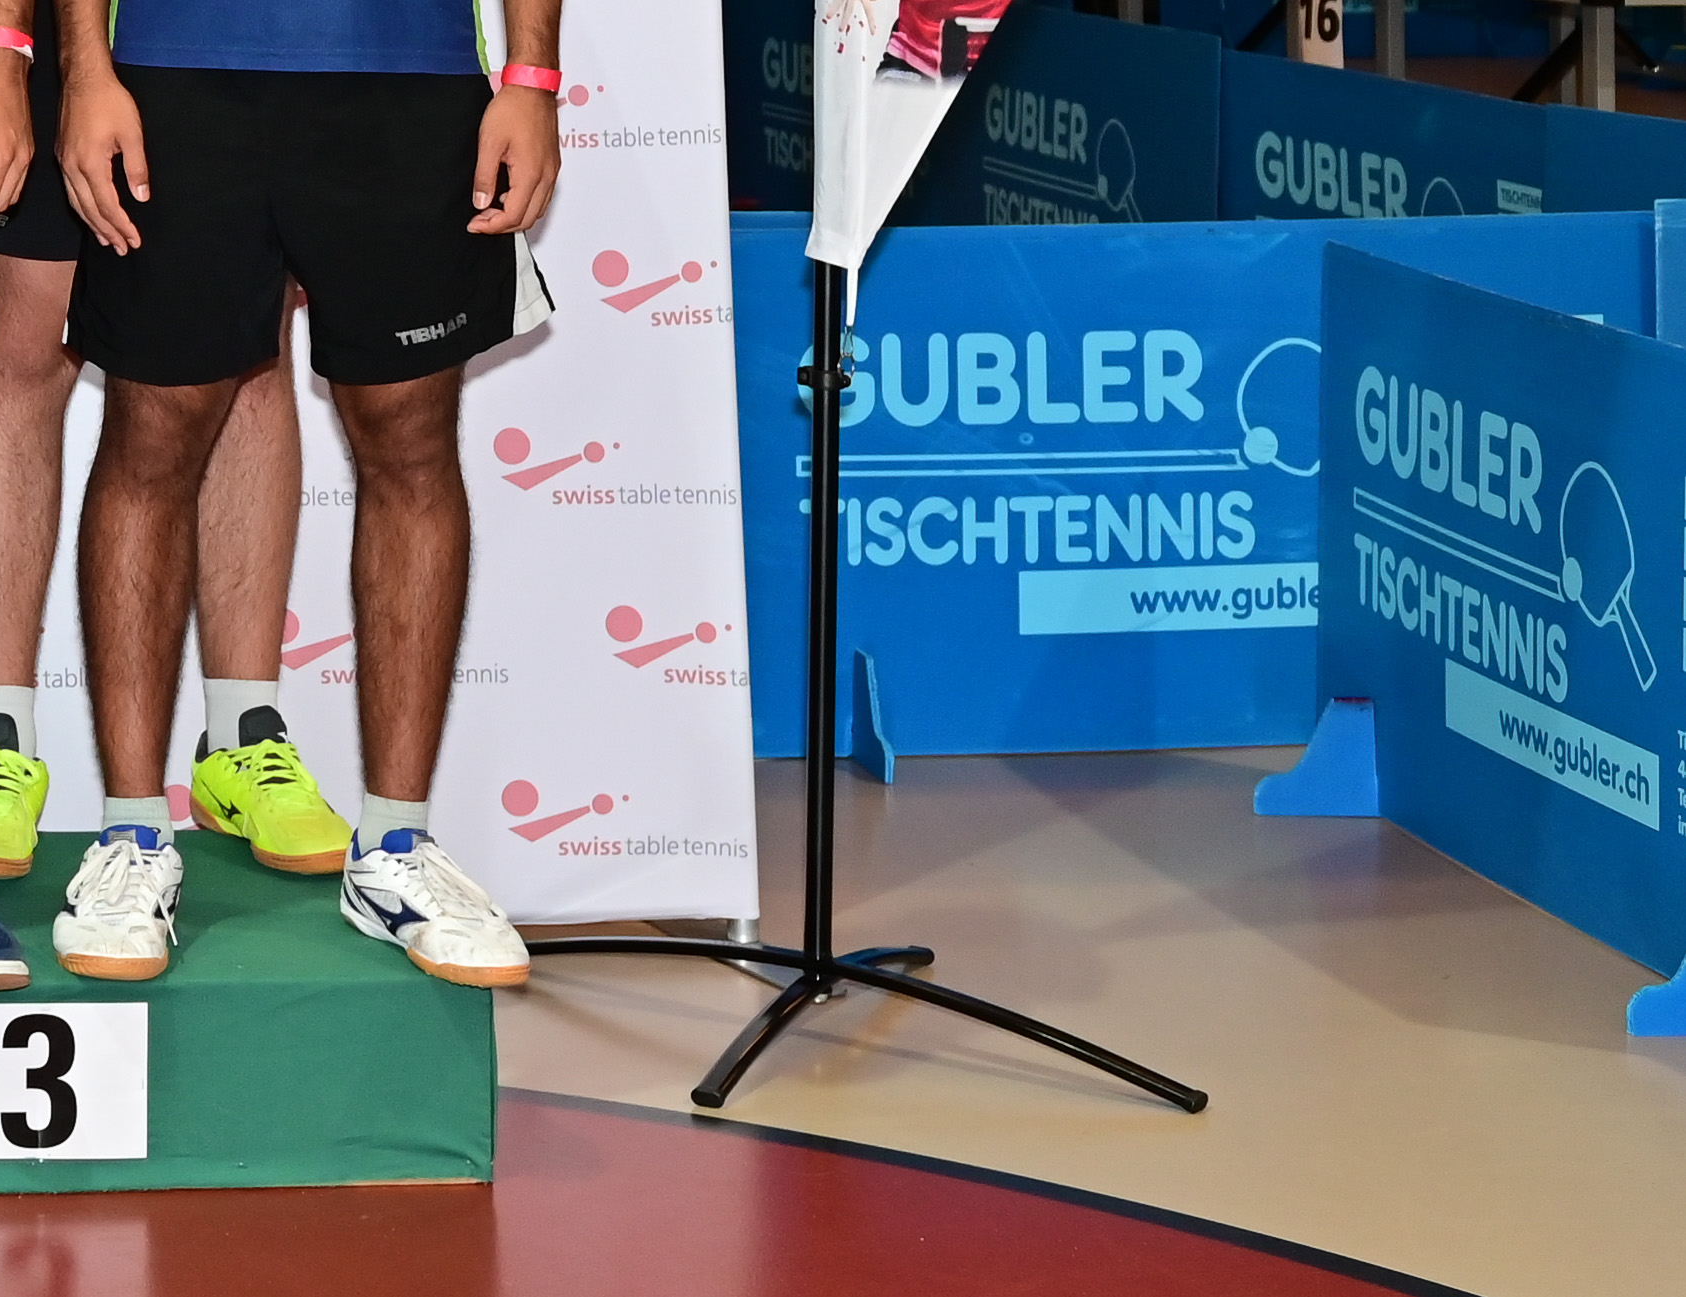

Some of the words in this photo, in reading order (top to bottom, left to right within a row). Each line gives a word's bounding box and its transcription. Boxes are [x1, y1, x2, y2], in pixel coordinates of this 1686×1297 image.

[985, 82, 1088, 165] GUBLER
[1255, 130, 1409, 218] GUBLER
[395, 312, 468, 347] TIBHAR
[800, 329, 1205, 426] GUBLER
[1354, 366, 1543, 535] GUBLER
[1353, 533, 1568, 704] TISCHTENNIS
[1499, 708, 1650, 807] www.gubler.ch
[0, 1014, 77, 1149] 3
